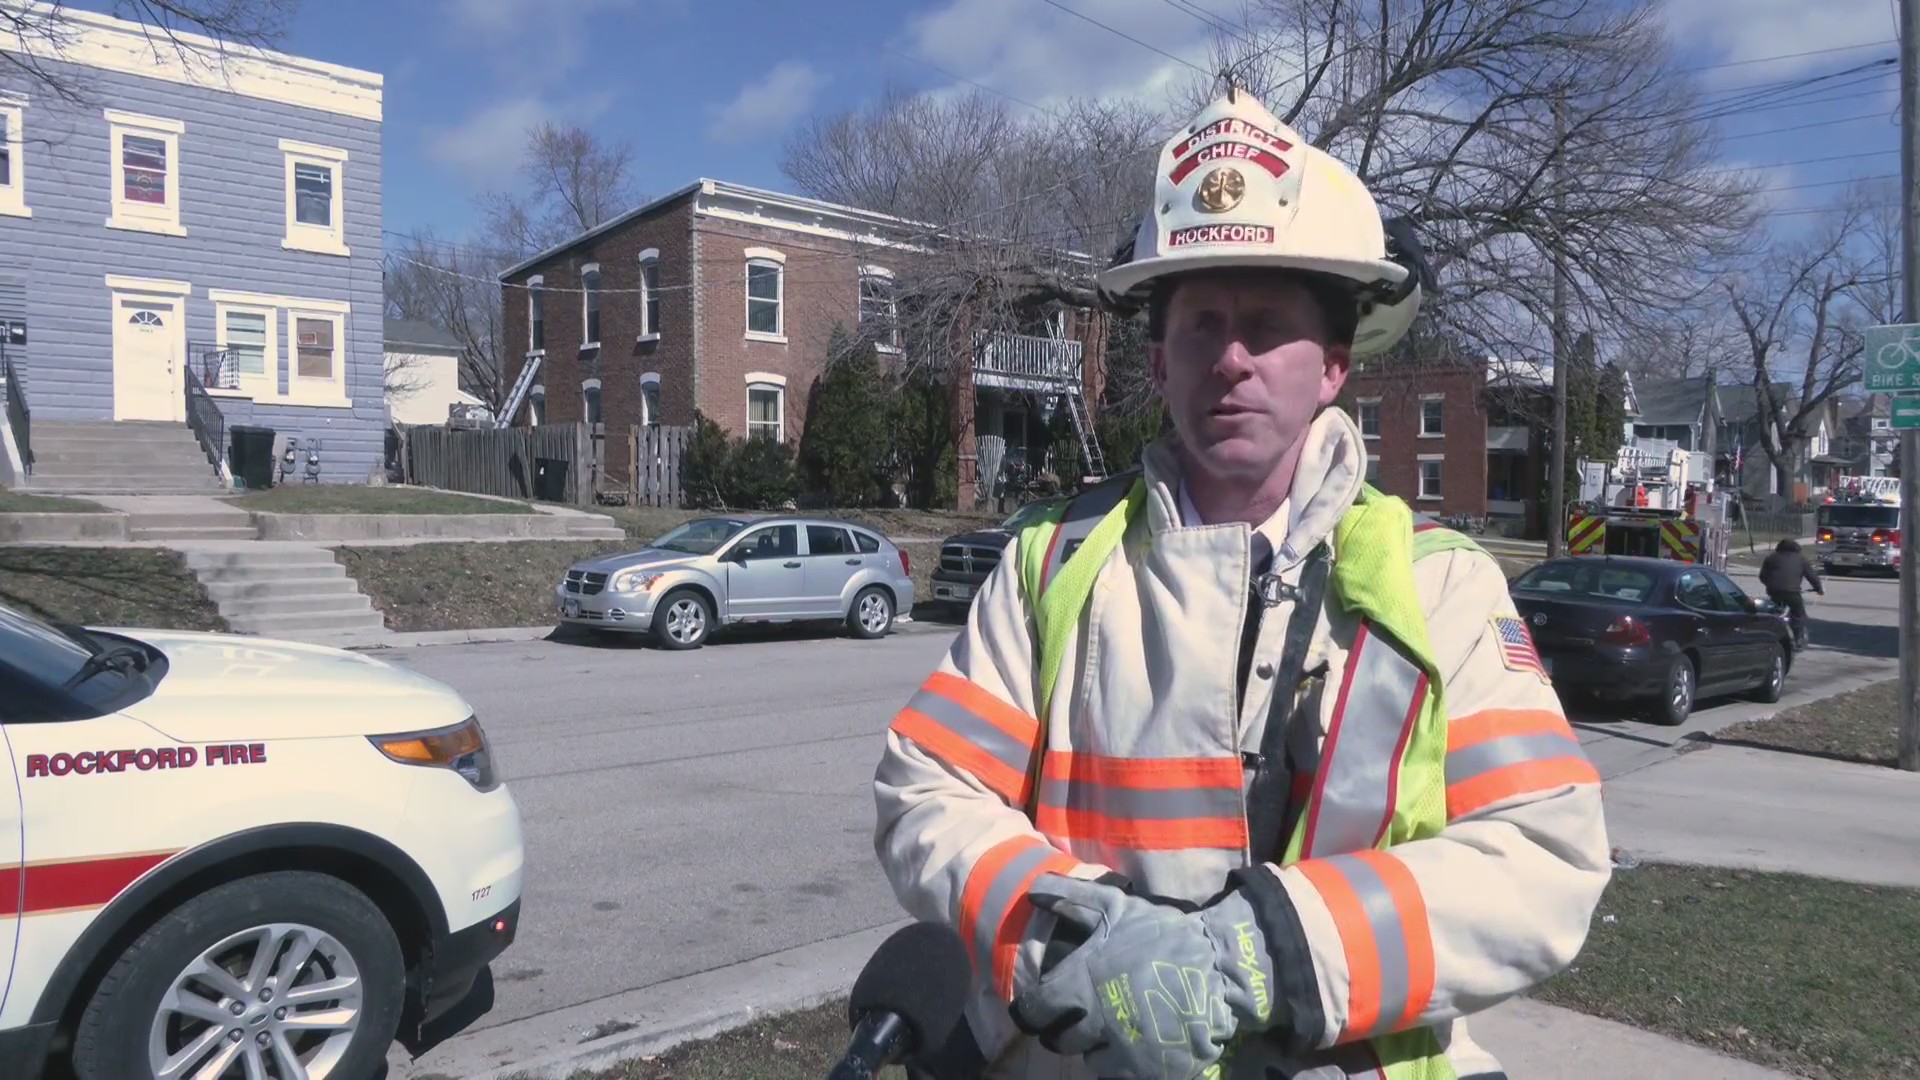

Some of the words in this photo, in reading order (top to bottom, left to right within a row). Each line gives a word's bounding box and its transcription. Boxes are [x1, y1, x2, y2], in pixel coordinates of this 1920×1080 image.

[1187, 119, 1280, 150] DISTRICT
[1197, 143, 1261, 163] CHIEF
[1175, 225, 1269, 245] ROCKFORD
[1872, 374, 1904, 387] BIKE
[26, 746, 199, 778] ROCKFORD
[205, 743, 267, 767] FIRE
[472, 885, 491, 901] 1727
[1234, 921, 1270, 1023] HexArmo
